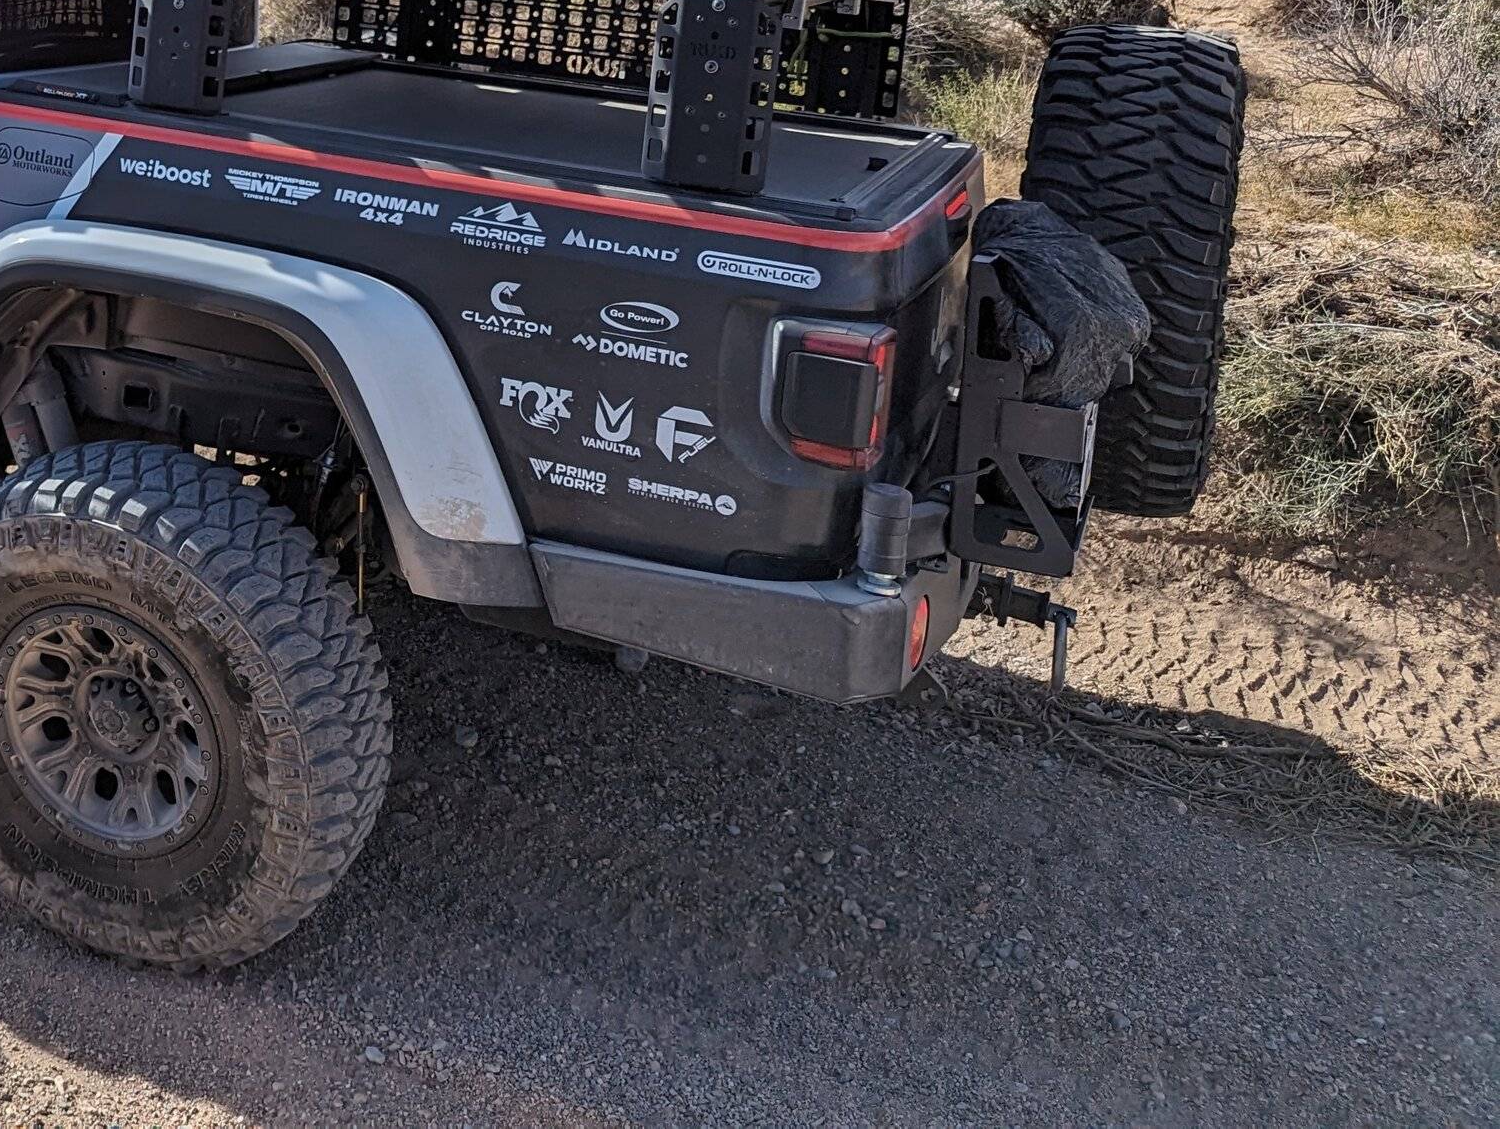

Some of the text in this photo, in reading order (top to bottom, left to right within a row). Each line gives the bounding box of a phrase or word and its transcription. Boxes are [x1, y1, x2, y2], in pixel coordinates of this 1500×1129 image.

[12, 159, 73, 177] MOTORWORKS
[13, 145, 74, 169] Outland
[228, 168, 320, 188] MICKEY THOMPSON
[334, 188, 440, 217] IRONMAN
[359, 207, 404, 226] 4x4
[450, 222, 547, 247] REDRIDGE
[463, 237, 529, 255] INDUSTRIES
[461, 310, 552, 336] CLAYTON
[609, 309, 665, 326] Go Power!
[479, 324, 532, 339] OFF ROAD
[599, 338, 689, 368] DOMETIC
[500, 377, 574, 430] FOX
[581, 436, 642, 458] VANULTRA
[678, 436, 716, 463] FUEL
[550, 473, 606, 495] WORKZ
[556, 463, 607, 483] PRIMO
[627, 477, 713, 507] SHERPA
[7, 570, 112, 594] LEGEND
